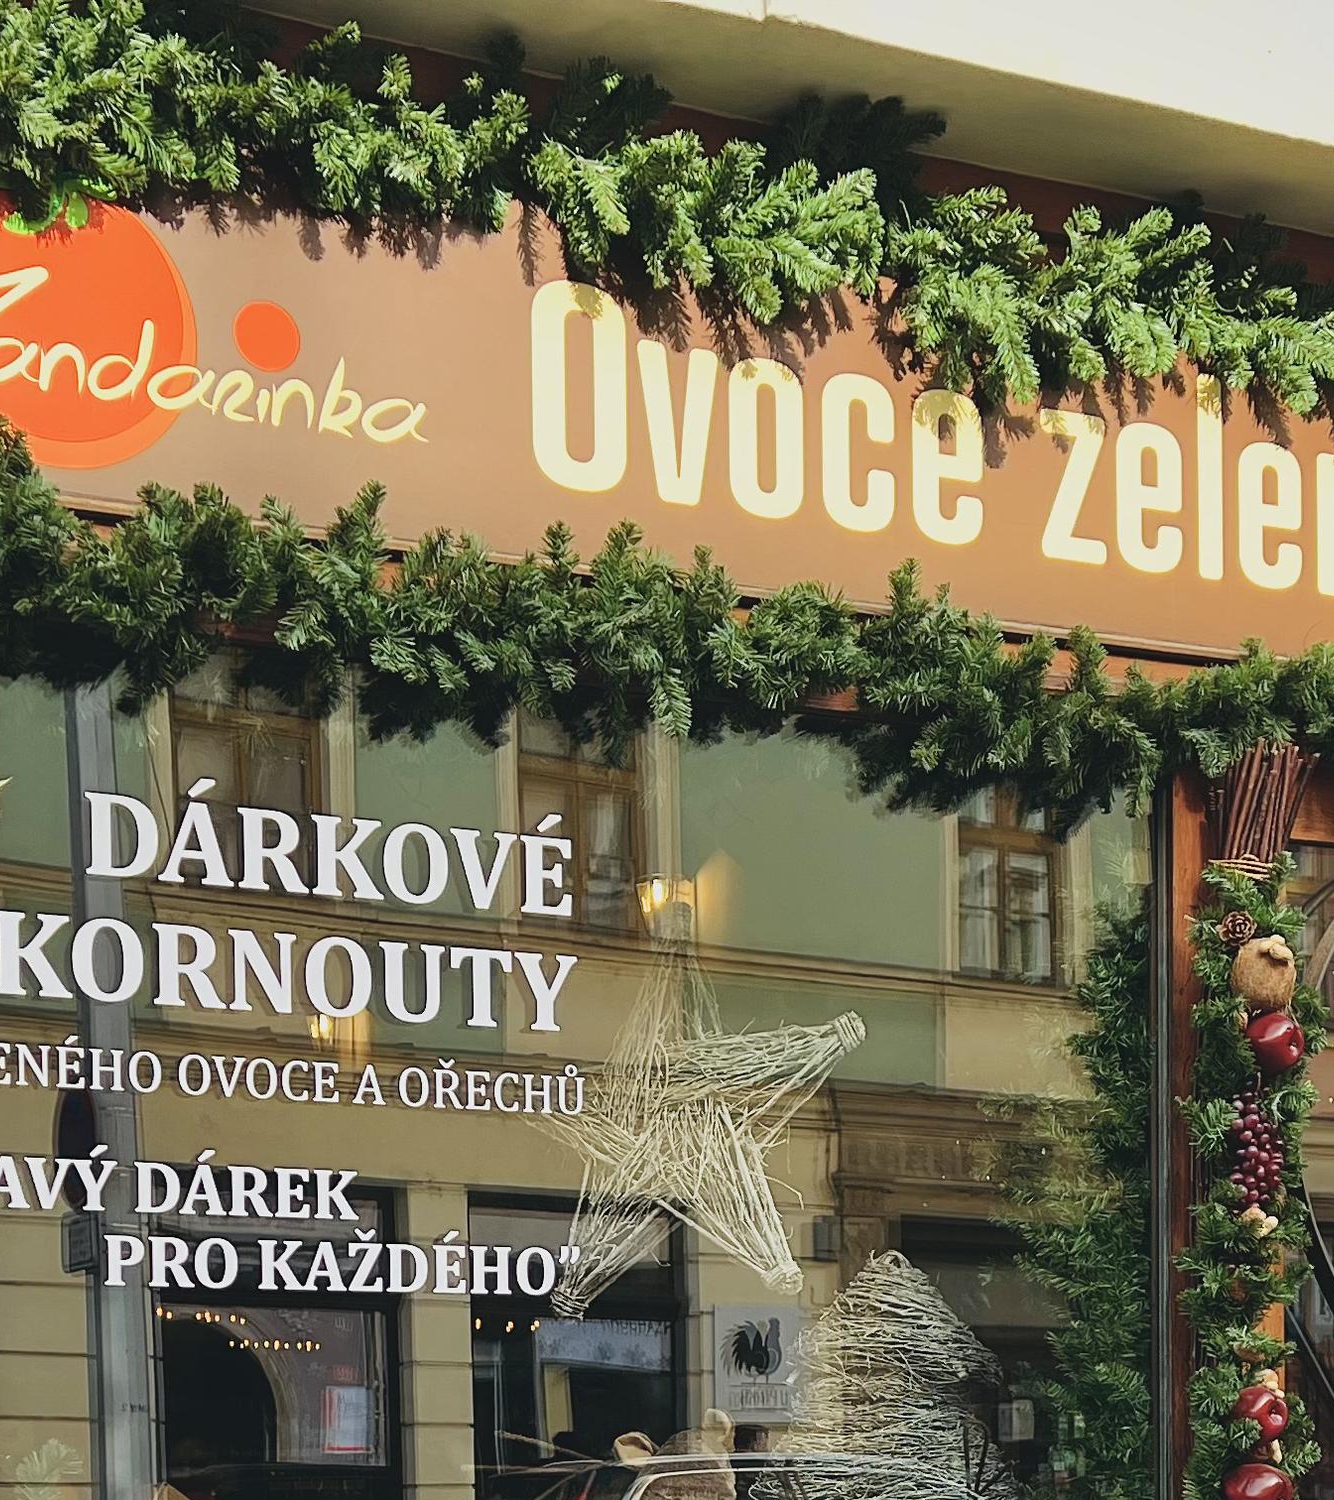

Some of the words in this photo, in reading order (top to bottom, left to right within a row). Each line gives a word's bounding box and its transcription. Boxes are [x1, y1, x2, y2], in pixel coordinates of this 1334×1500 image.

[531, 280, 984, 546] Ovoce
[84, 778, 574, 917] DÁRKOVÉ
[177, 1053, 339, 1104] OVOCE
[354, 1069, 386, 1106] A
[397, 1056, 585, 1116] OŘECHŮ
[134, 1150, 358, 1221] DÁREK
[103, 1234, 239, 1289] PRO
